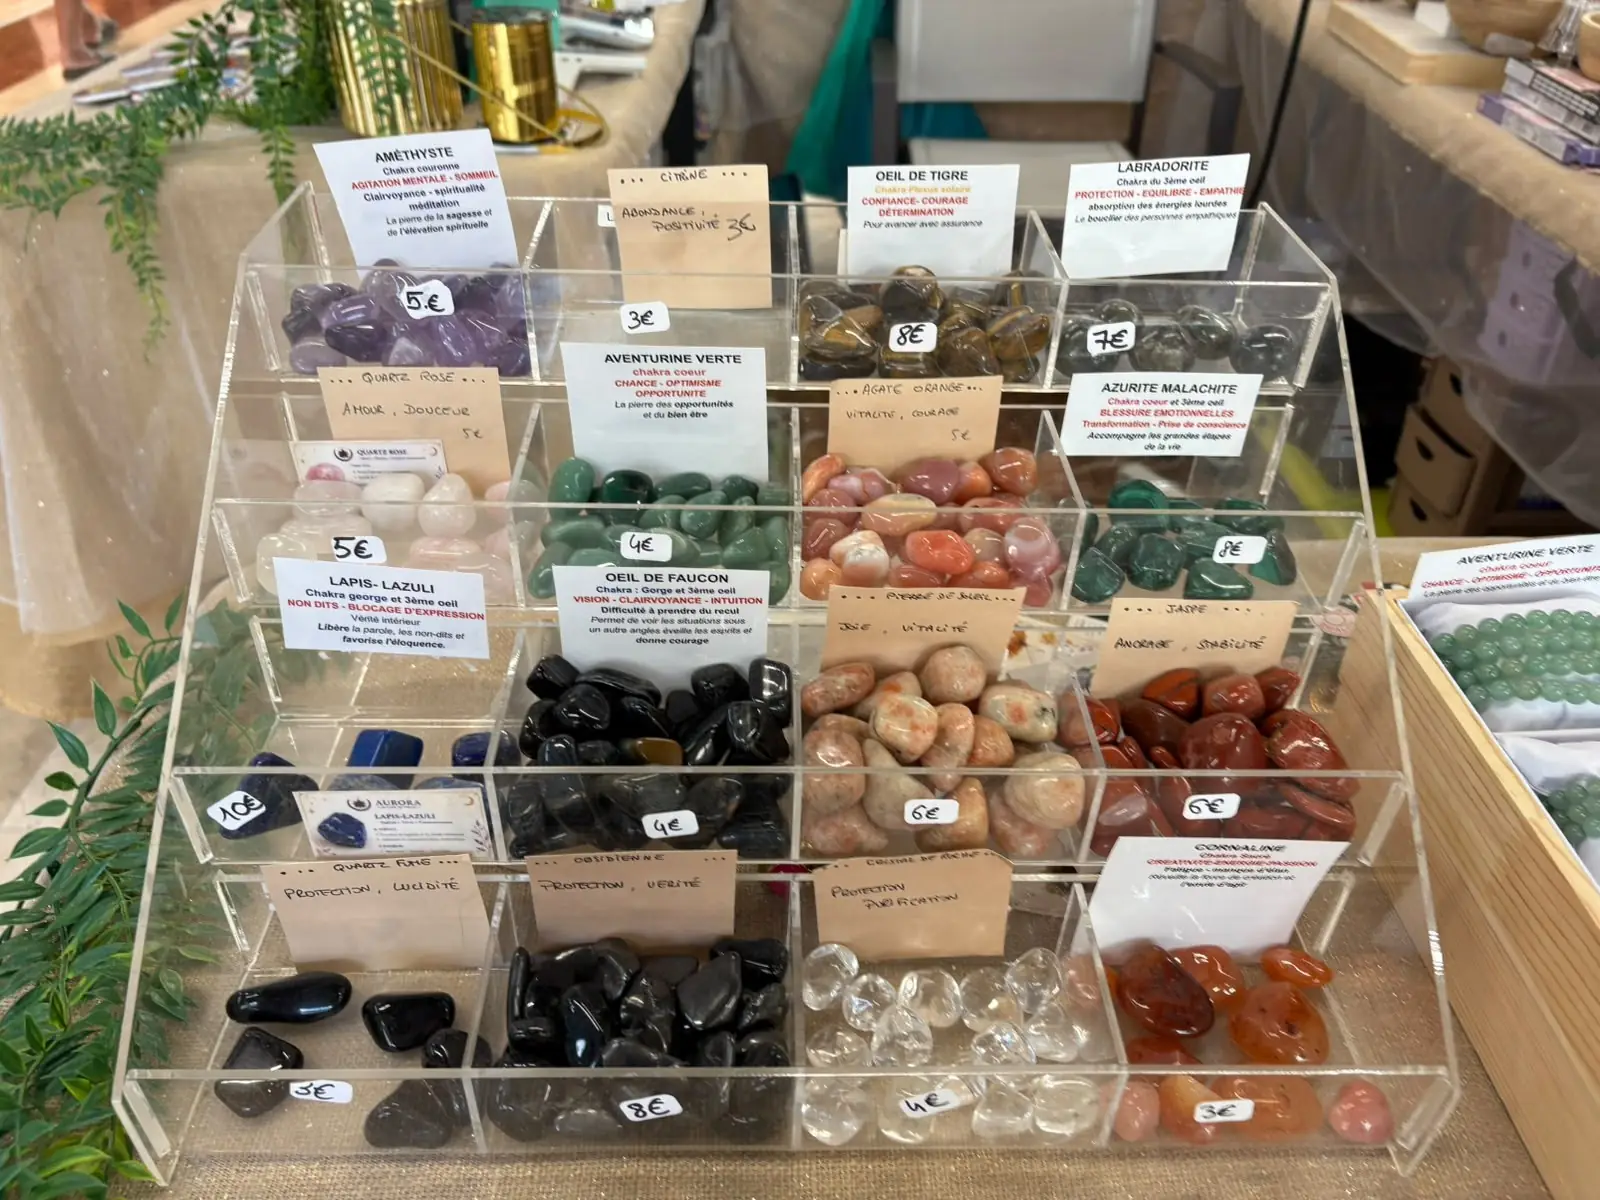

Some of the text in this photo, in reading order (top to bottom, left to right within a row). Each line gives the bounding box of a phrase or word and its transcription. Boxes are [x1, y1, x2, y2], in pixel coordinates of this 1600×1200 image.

[383, 162, 459, 176] Chakra couronne
[1118, 161, 1209, 173] LABRADORITE
[351, 170, 498, 190] AGITATION MENTALE SOMMEIL
[876, 171, 968, 181] OEIL DE TIGRE
[1117, 178, 1147, 186] Chakra
[364, 183, 485, 202] Clairvoyance spiritualité
[1075, 187, 1246, 199] PROTECTION EQUILIBRE EMPATHIE
[409, 199, 459, 211] méditation
[922, 196, 968, 205] COURAGE
[1088, 200, 1227, 211] absorption énergies lourdes
[446, 210, 481, 221] sagesse
[879, 208, 954, 217] DÉTERMINATION
[1087, 212, 1236, 222] bouclier personnes empathiques
[400, 221, 488, 235] l'élévation spirituelle
[726, 213, 756, 241] 3€
[628, 310, 654, 329] 3€
[897, 324, 925, 345] 8€
[1093, 329, 1128, 350] 7€
[604, 354, 741, 364] AVENTURINE VERTE
[362, 372, 454, 384] QUARTZ ROSE
[863, 383, 964, 395] AGATE ORANGE
[1102, 383, 1237, 394] AZURITE MALACHITE
[404, 403, 470, 416] DOUCEUR
[628, 401, 733, 409] pierre opportunités
[1100, 409, 1151, 417] BLESSURE
[1083, 420, 1150, 428] Transformation
[1087, 432, 1231, 441] Accompagne grandes étapes
[333, 537, 372, 559] 5€
[630, 534, 653, 553] 4€
[1219, 541, 1243, 557] 8€
[1457, 544, 1595, 564] AVENTURINE VERTE
[606, 573, 728, 583] OEIL DE FAUCON
[382, 581, 434, 593] LAZULI
[642, 587, 673, 595] Gorge
[306, 589, 458, 607] Chakra george 3ème oeil
[288, 599, 484, 620] NON DITS BLOCAGE D'EXPRESSION
[382, 617, 420, 626] intérieur
[318, 623, 453, 639] Libère non-dits
[710, 627, 740, 635] esprits
[343, 636, 445, 648] favorise l'éloquence.
[219, 795, 263, 821] 10€
[1189, 798, 1224, 814] 6€
[912, 805, 940, 820] 6€
[654, 818, 683, 835] 4€
[1195, 844, 1287, 852] CORNALINE
[333, 862, 389, 872] QUARTZ
[627, 1098, 670, 1118] 8€
